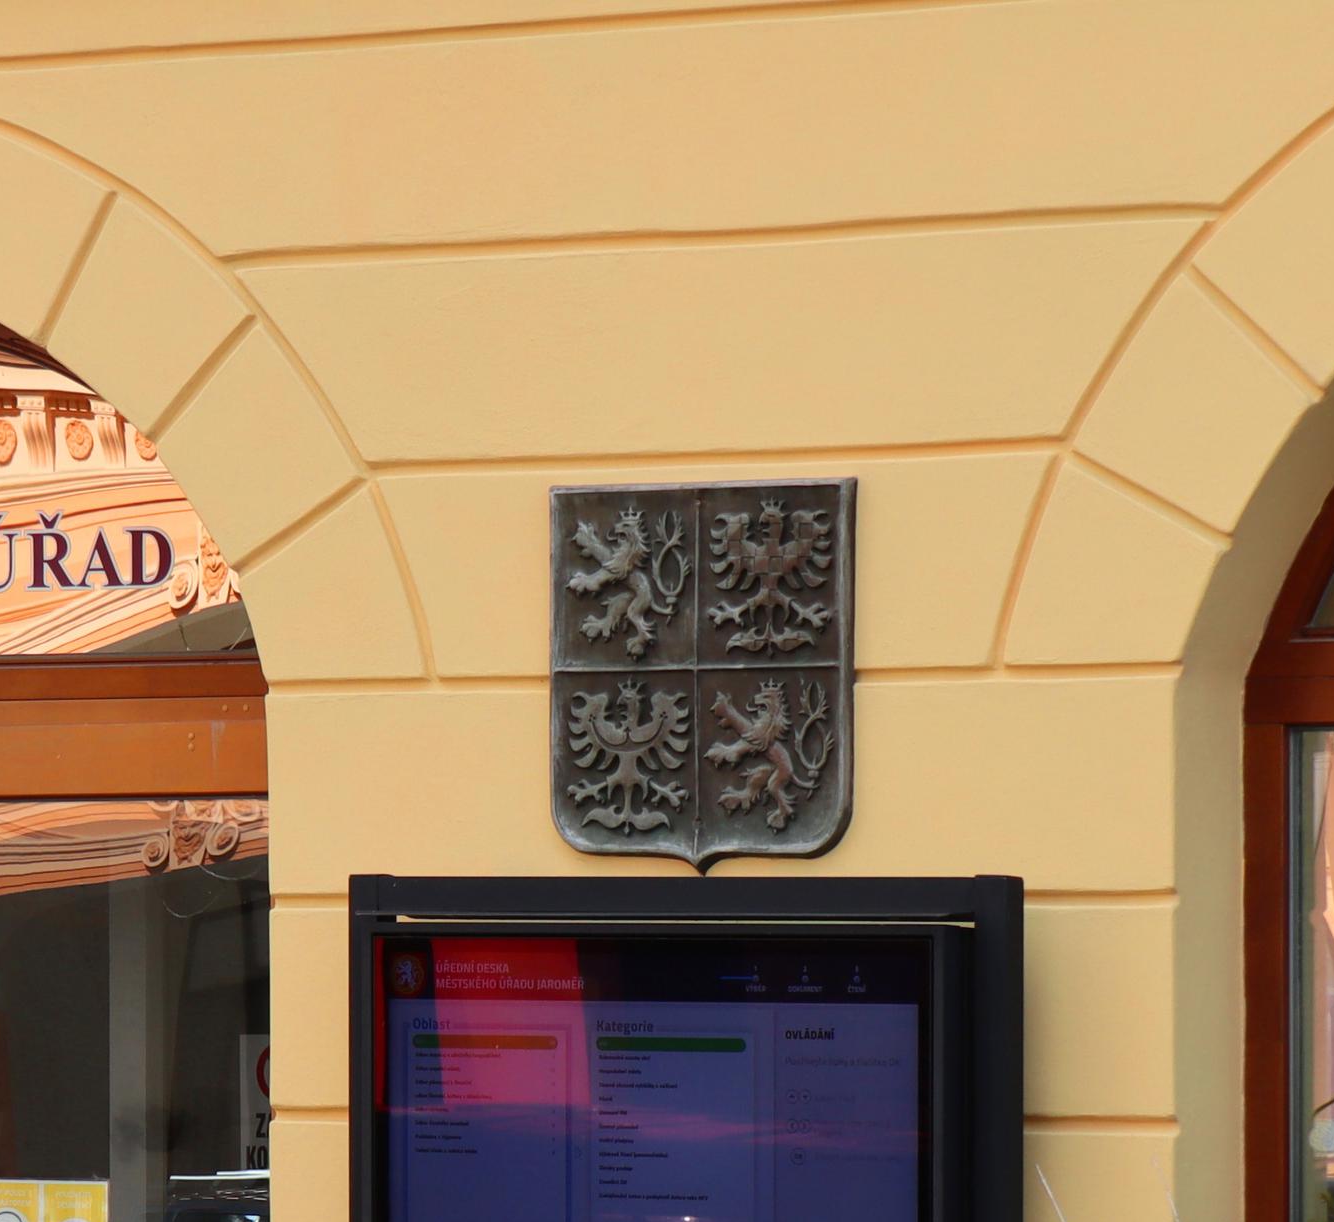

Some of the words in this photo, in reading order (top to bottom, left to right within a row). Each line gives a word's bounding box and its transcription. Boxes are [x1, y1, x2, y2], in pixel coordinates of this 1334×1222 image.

[435, 960, 474, 974] ÚŘEDNÍ
[476, 962, 510, 974] DESKA
[435, 975, 497, 990] MĚSTSKÉHO
[498, 976, 535, 991] ÚŘADU
[536, 976, 585, 992] JAROMĚŘ
[411, 1017, 451, 1029] Oblast
[595, 1019, 654, 1035] Kategorie
[784, 1027, 836, 1041] OVLÁDÁNÍ
[256, 1112, 269, 1138] Z
